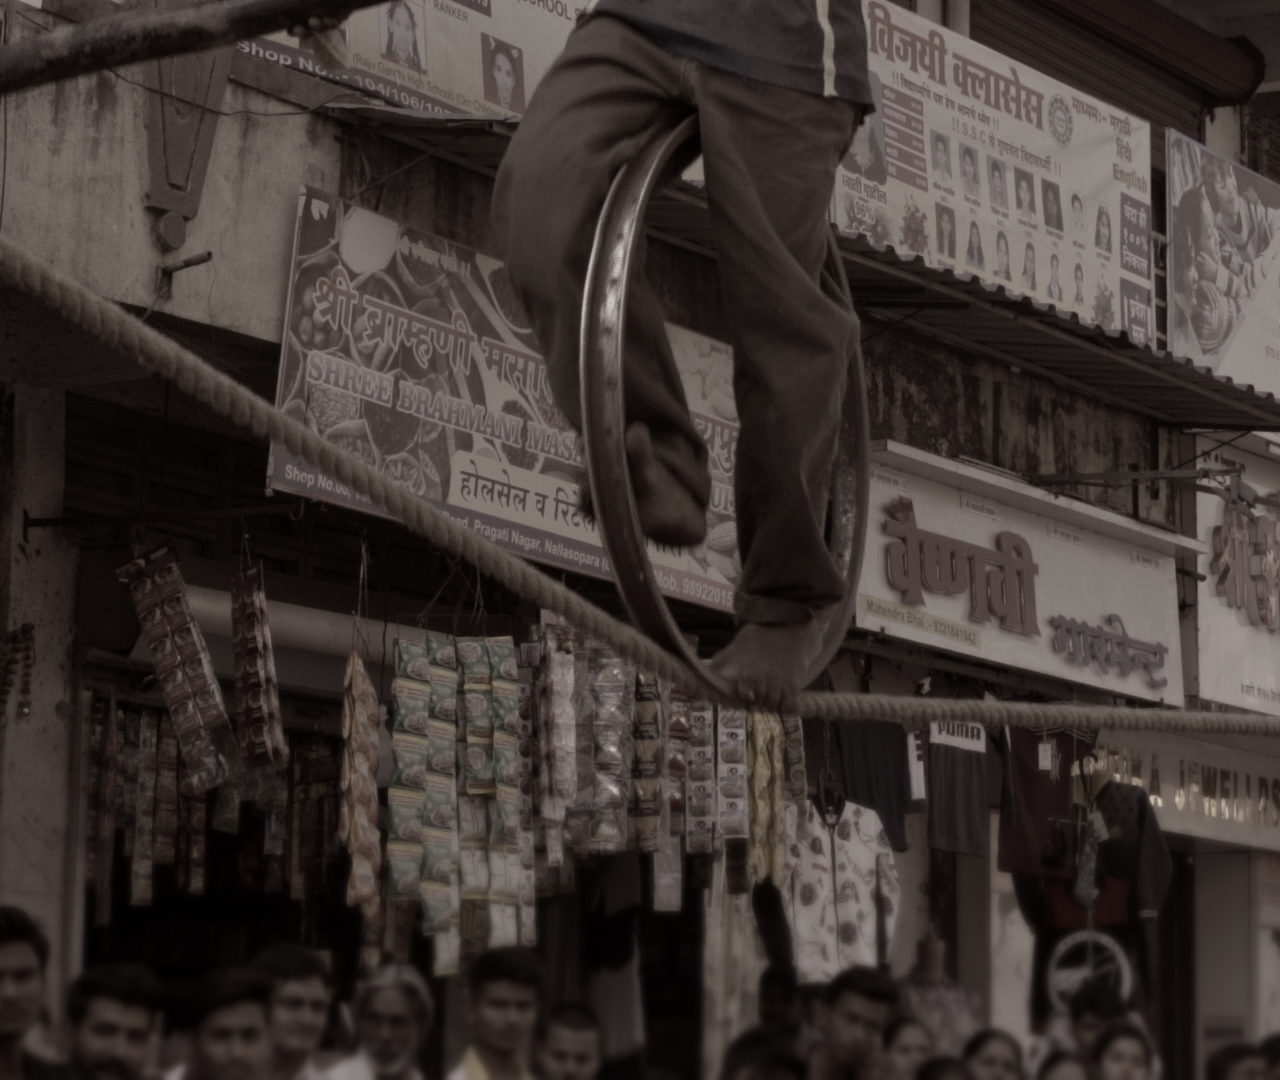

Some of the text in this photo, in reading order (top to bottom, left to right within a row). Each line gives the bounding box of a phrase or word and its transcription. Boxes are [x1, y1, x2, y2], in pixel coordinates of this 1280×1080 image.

[313, 267, 358, 334] श्री
[306, 350, 523, 448] SHREE BRAHMANI
[284, 464, 315, 487] Shop
[474, 521, 509, 543] Pragati
[511, 529, 542, 553] Nagar,
[544, 538, 600, 568] Nallasopara
[460, 459, 548, 518] होलसेल व
[866, 599, 906, 625] Mahendra
[937, 721, 981, 741] PUMA
